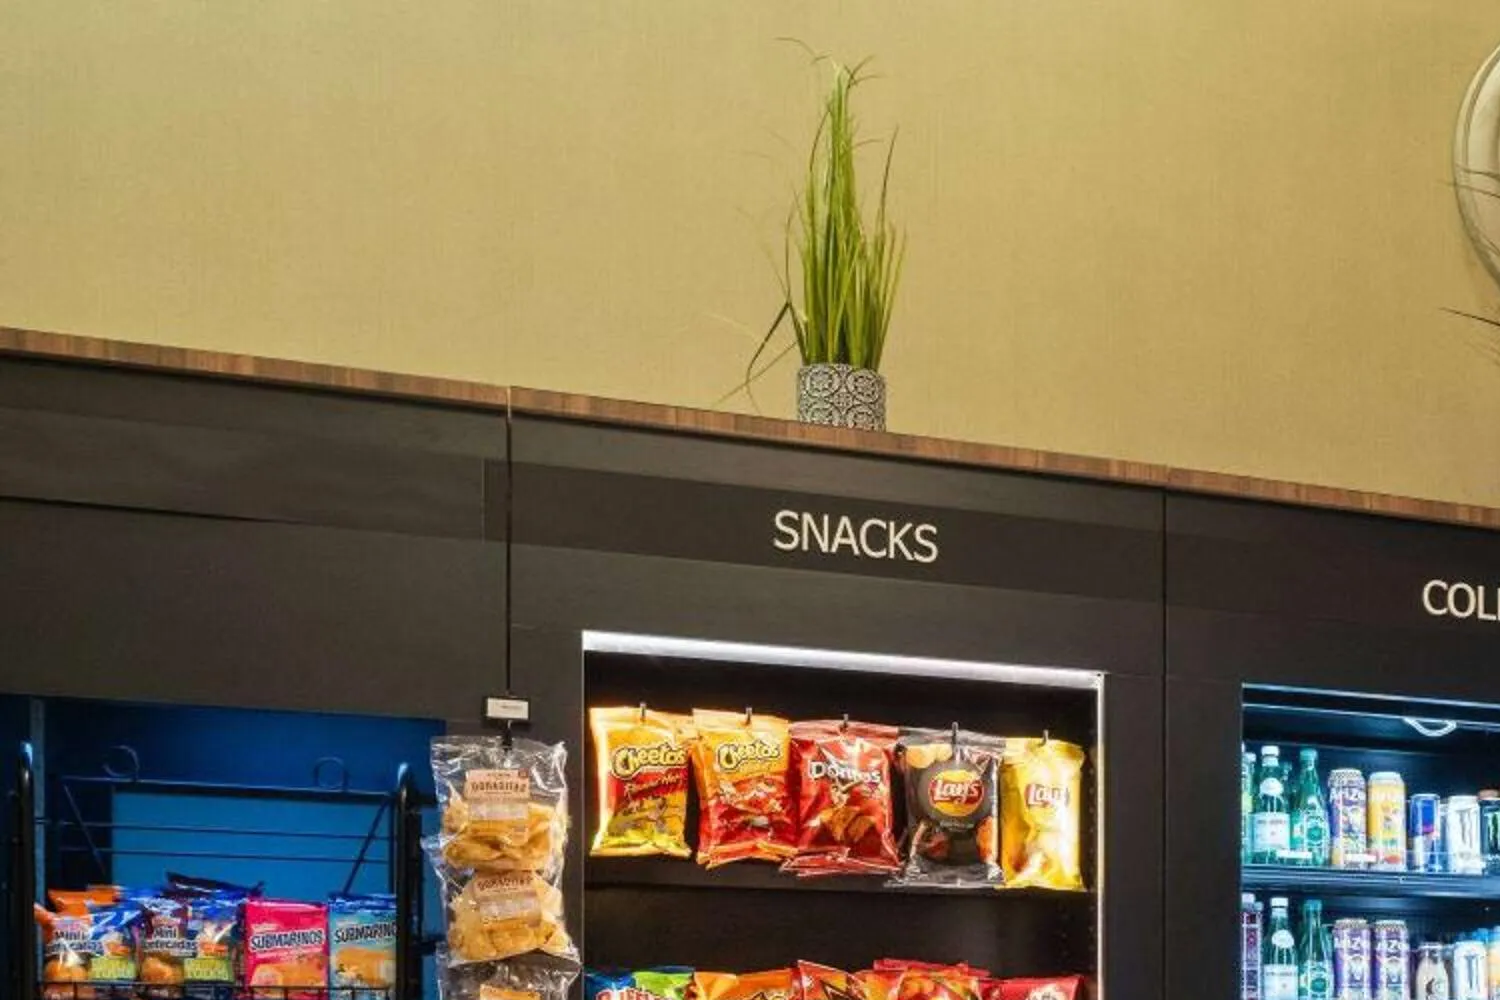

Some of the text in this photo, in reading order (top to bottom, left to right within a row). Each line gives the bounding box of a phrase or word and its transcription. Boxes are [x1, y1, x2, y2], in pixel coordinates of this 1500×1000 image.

[773, 508, 940, 564] SNACKS
[611, 742, 689, 780] Cheetos
[716, 739, 783, 772] Cheetos
[251, 929, 324, 952] SUBMARINOS
